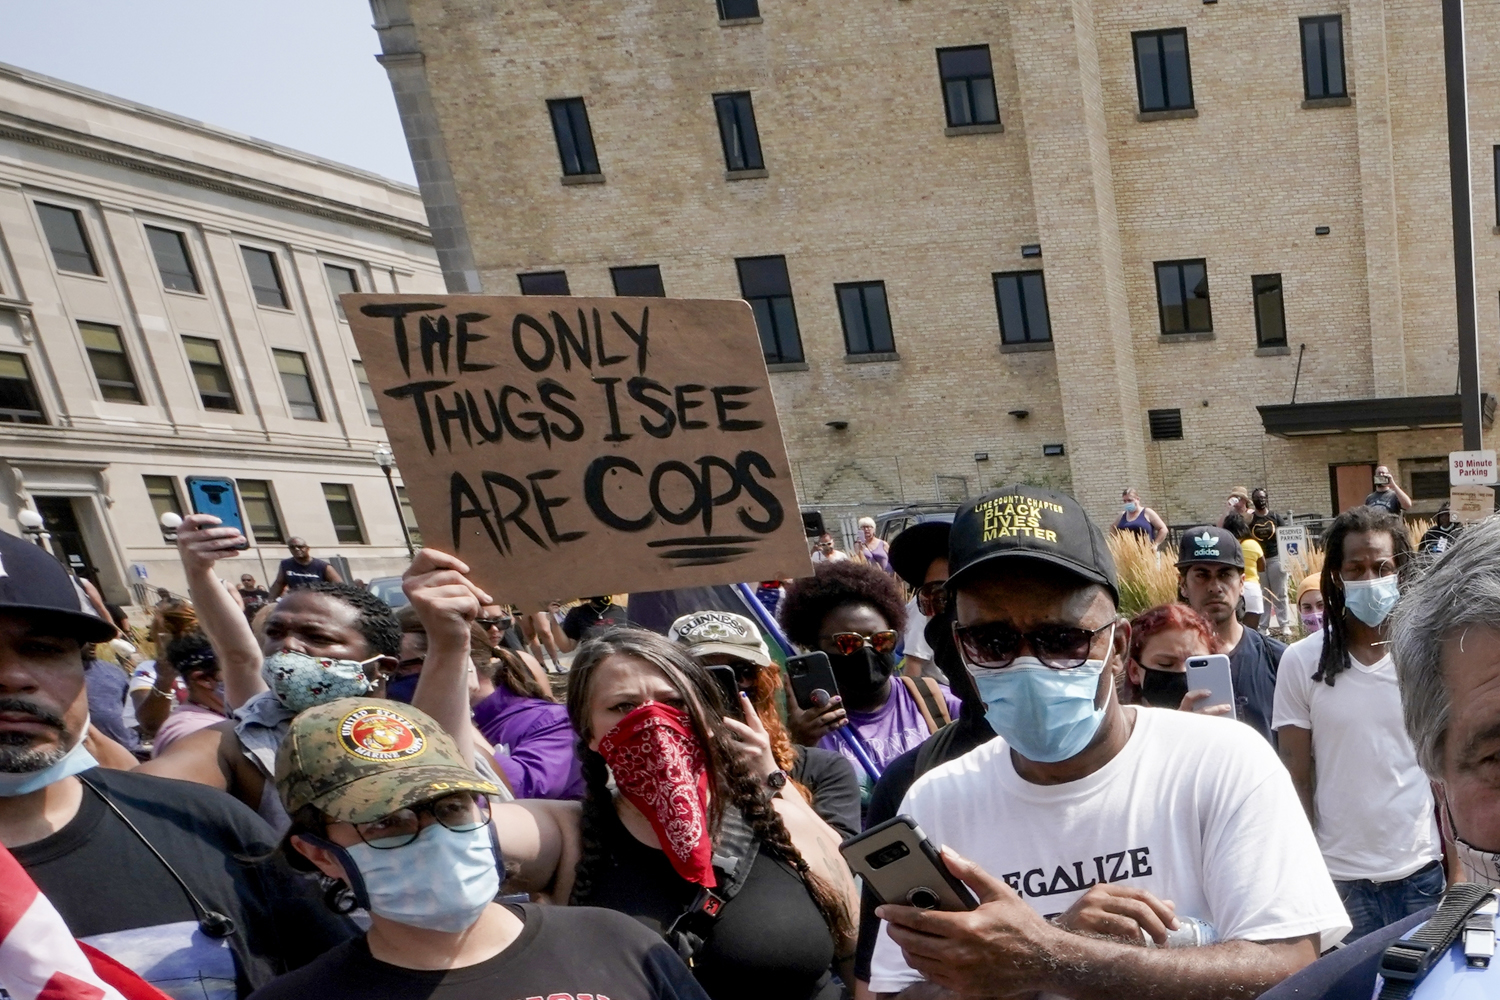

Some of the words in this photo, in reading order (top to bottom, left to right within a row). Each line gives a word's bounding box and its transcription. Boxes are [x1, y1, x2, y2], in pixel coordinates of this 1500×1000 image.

[359, 302, 499, 379] THE
[511, 306, 650, 377] ONLY
[383, 378, 585, 458] THUGS
[593, 376, 633, 442] I
[627, 376, 767, 440] SEE
[1454, 460, 1464, 468] 30
[1466, 459, 1493, 468] Minute
[1459, 468, 1488, 477] Parking
[449, 468, 589, 558] ARE
[583, 450, 785, 536] COPS
[984, 503, 1042, 520] BLACK
[993, 495, 1025, 507] COUNTY
[1026, 497, 1064, 514] CHAPTER
[984, 515, 1040, 531] LIVES
[983, 526, 1058, 543] MATTER
[1194, 548, 1220, 557] adidas
[679, 613, 746, 636] GUINNESS
[341, 709, 369, 736] UNITED
[376, 709, 415, 729] STATES
[354, 746, 401, 760] MARINE
[1002, 846, 1153, 899] EGALIZE
